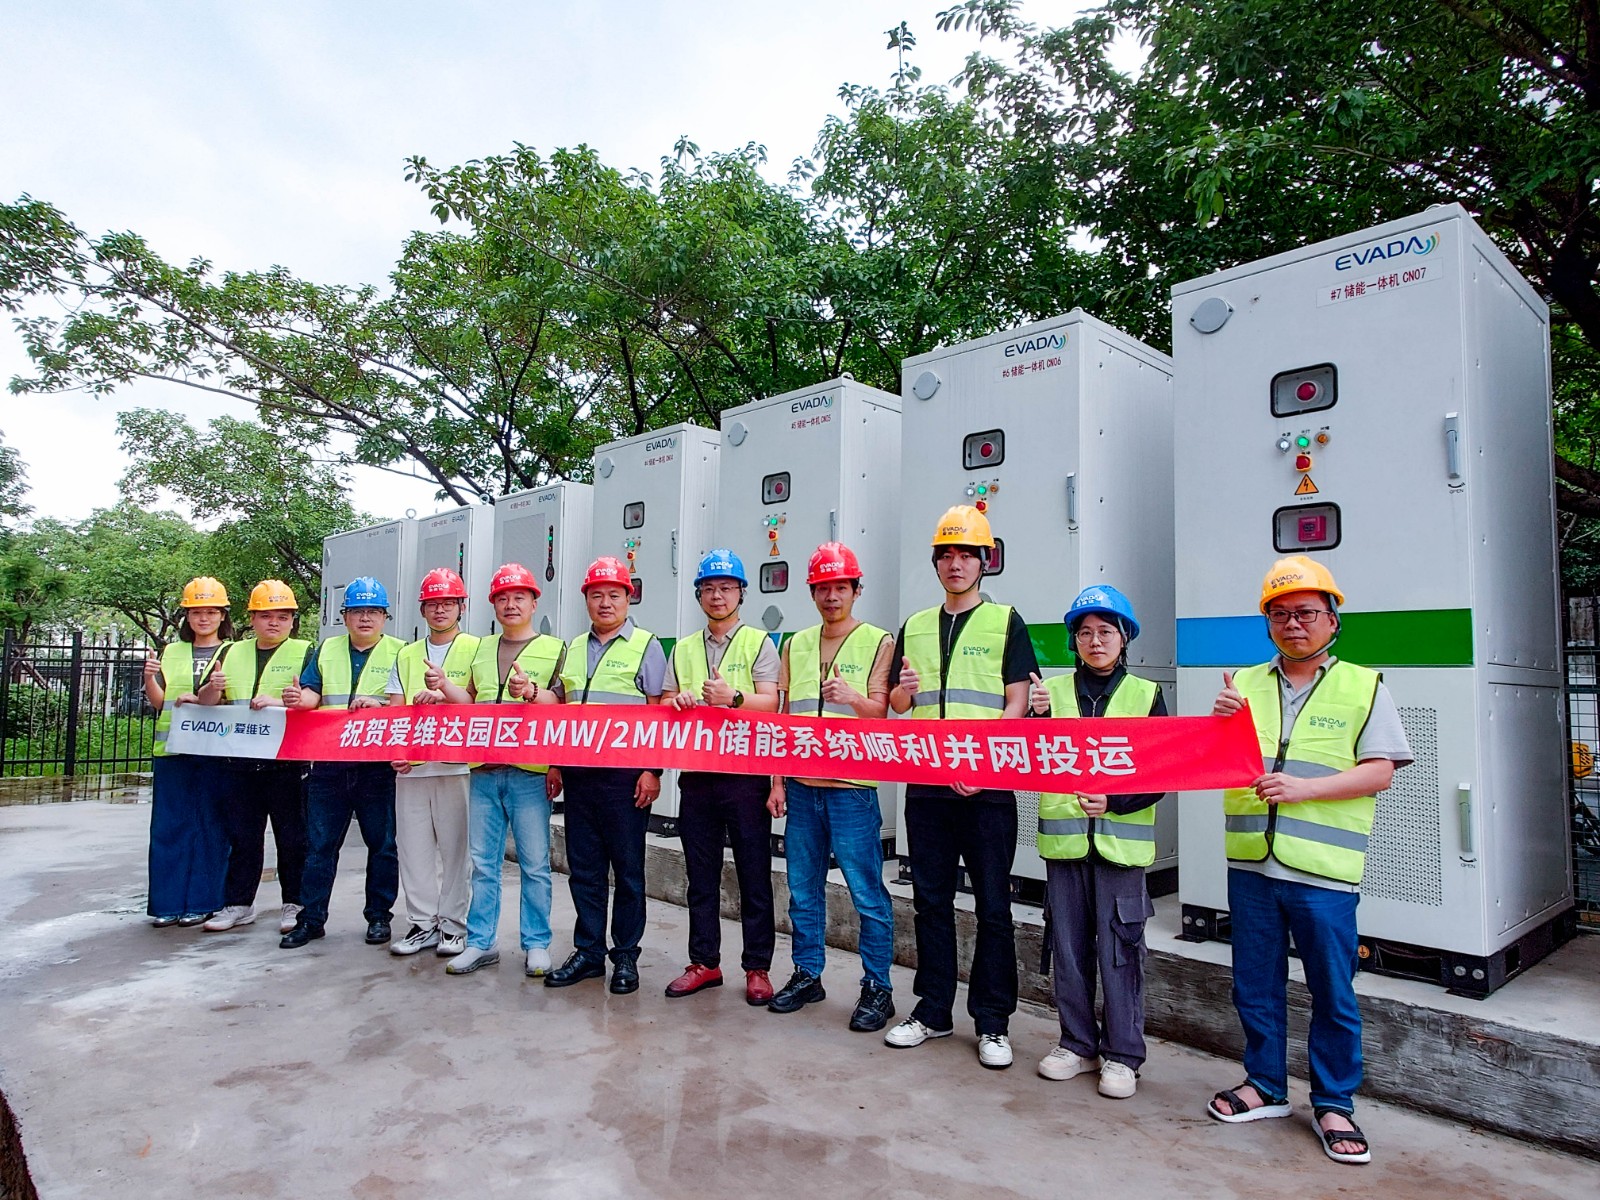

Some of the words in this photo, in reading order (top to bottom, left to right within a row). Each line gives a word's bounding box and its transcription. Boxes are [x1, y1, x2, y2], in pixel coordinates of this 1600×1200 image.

[1335, 234, 1430, 271] EVADA
[1330, 288, 1342, 300] #7
[1344, 273, 1400, 299] 储能一体机
[1402, 267, 1427, 283] CN07
[1004, 333, 1063, 358] EVADA
[791, 395, 830, 413] EVADA
[645, 437, 675, 452] EVADA
[1271, 573, 1301, 585] EVADA
[963, 645, 989, 653] EVADA
[840, 663, 861, 671] EVADA
[180, 720, 227, 735] EVADA
[233, 722, 271, 736] 爱维达
[1310, 715, 1342, 727] EVADA
[339, 715, 1137, 777] 祝贺爱维达园区1MW/2MWh储能系统顺利并网投运
